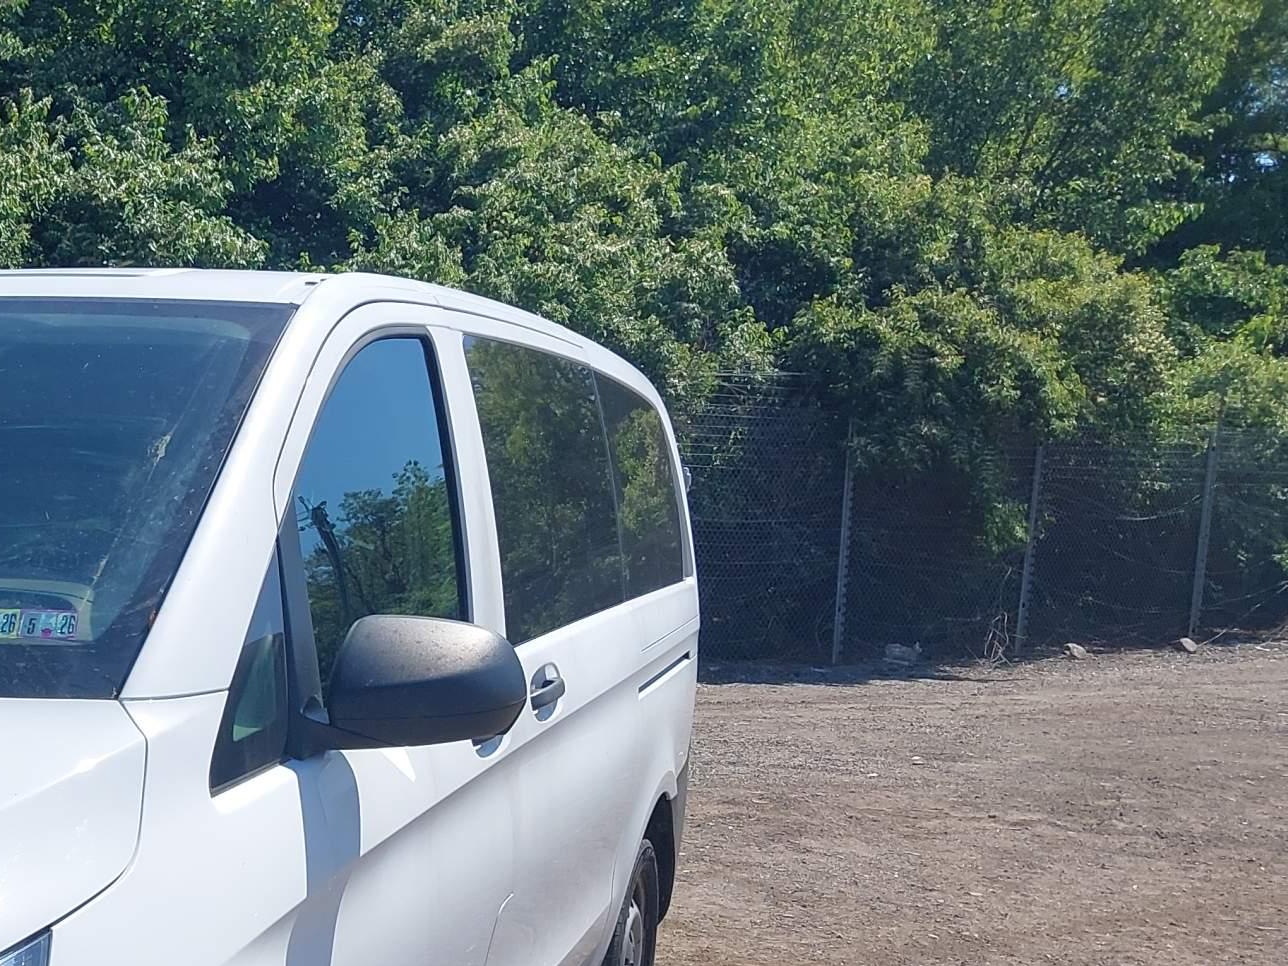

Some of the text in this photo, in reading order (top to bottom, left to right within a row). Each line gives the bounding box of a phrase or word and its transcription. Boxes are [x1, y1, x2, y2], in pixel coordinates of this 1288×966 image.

[0, 613, 17, 633] 26
[27, 614, 76, 635] 5 26
